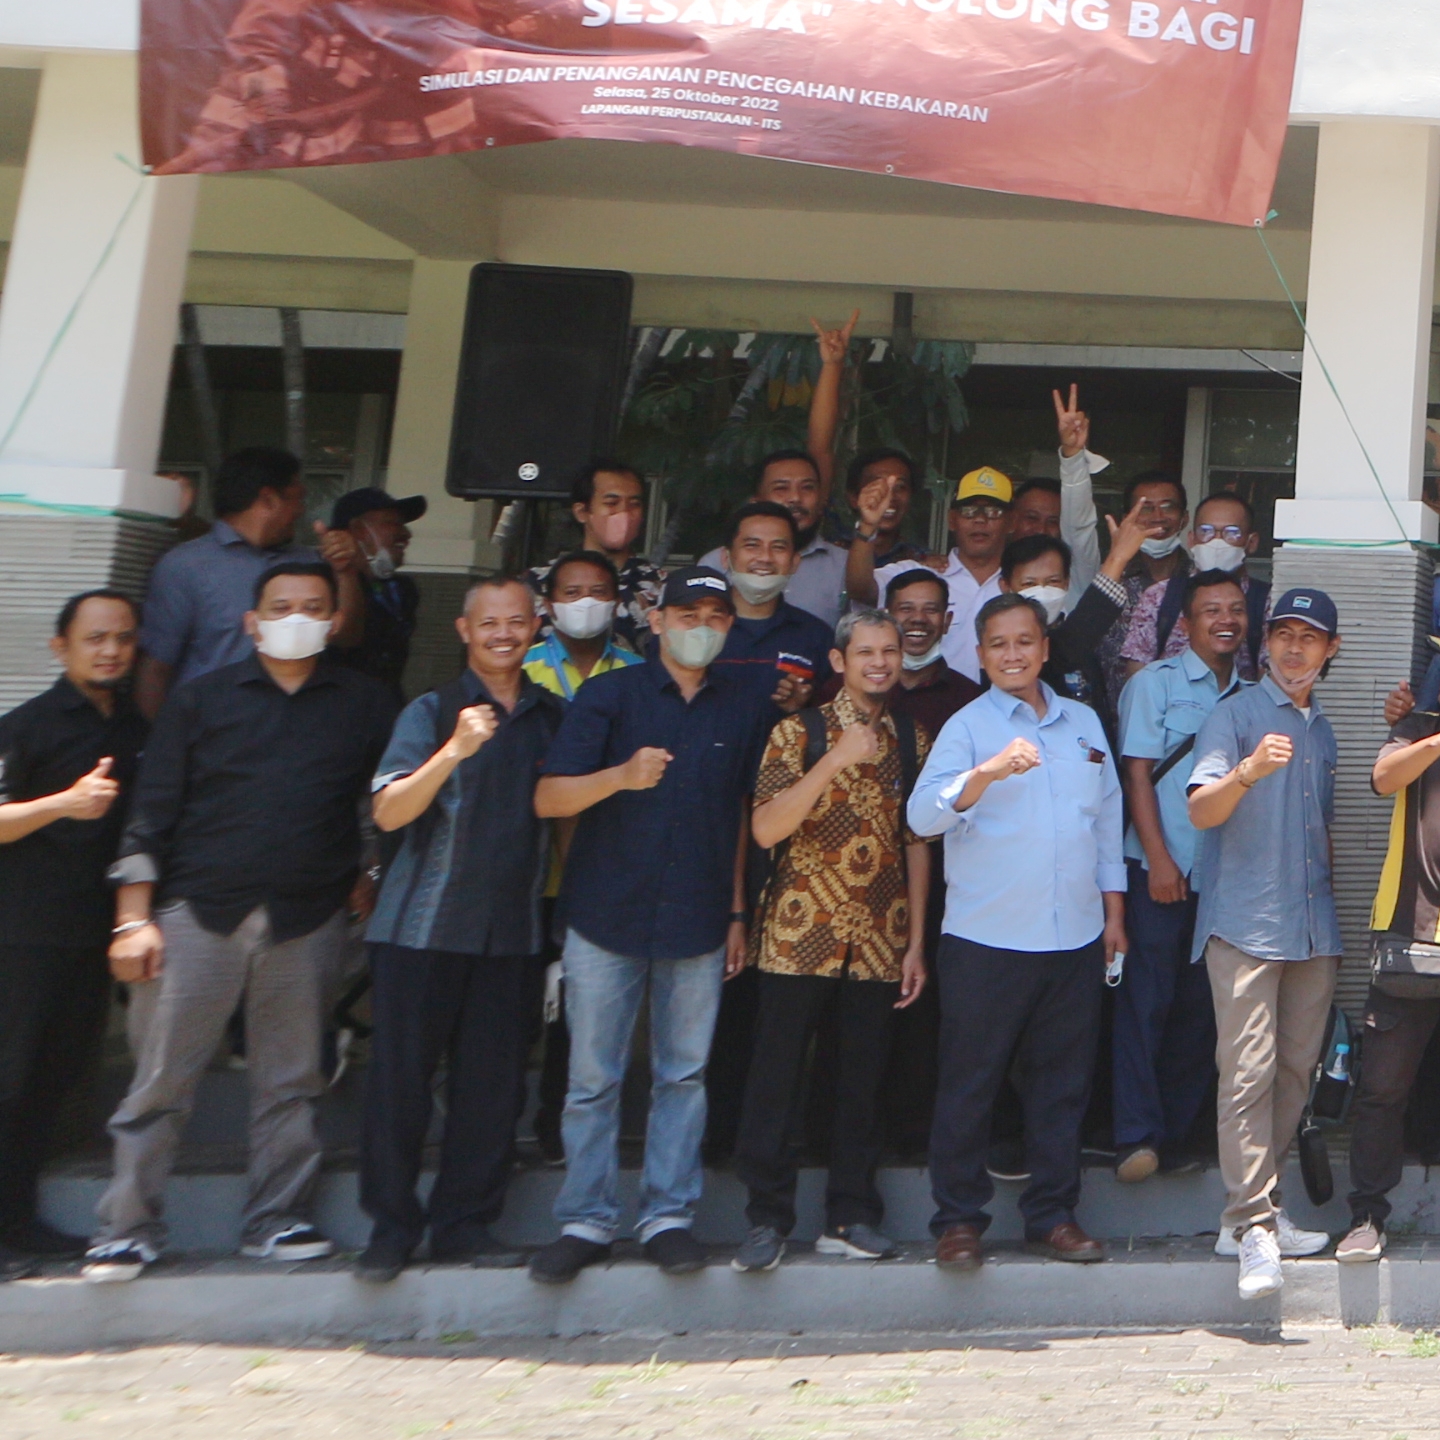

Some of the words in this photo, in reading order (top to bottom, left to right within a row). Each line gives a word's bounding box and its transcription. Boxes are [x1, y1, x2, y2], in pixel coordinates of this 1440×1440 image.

[1127, 0, 1255, 55] BAGI
[419, 69, 500, 93] SIMULASI
[505, 67, 551, 84] DAN
[553, 66, 701, 83] PENANGANAN
[704, 68, 855, 104] PENCEGAHAN
[859, 89, 988, 123] KEBAKARAN
[593, 86, 648, 100] Selasa,
[651, 87, 671, 99] 25
[674, 88, 738, 106] Oktober
[740, 95, 780, 112] 2022
[581, 104, 649, 116] LAPANGAN
[651, 106, 752, 126] PERPUSTAKAAN
[761, 117, 782, 131] ITS
